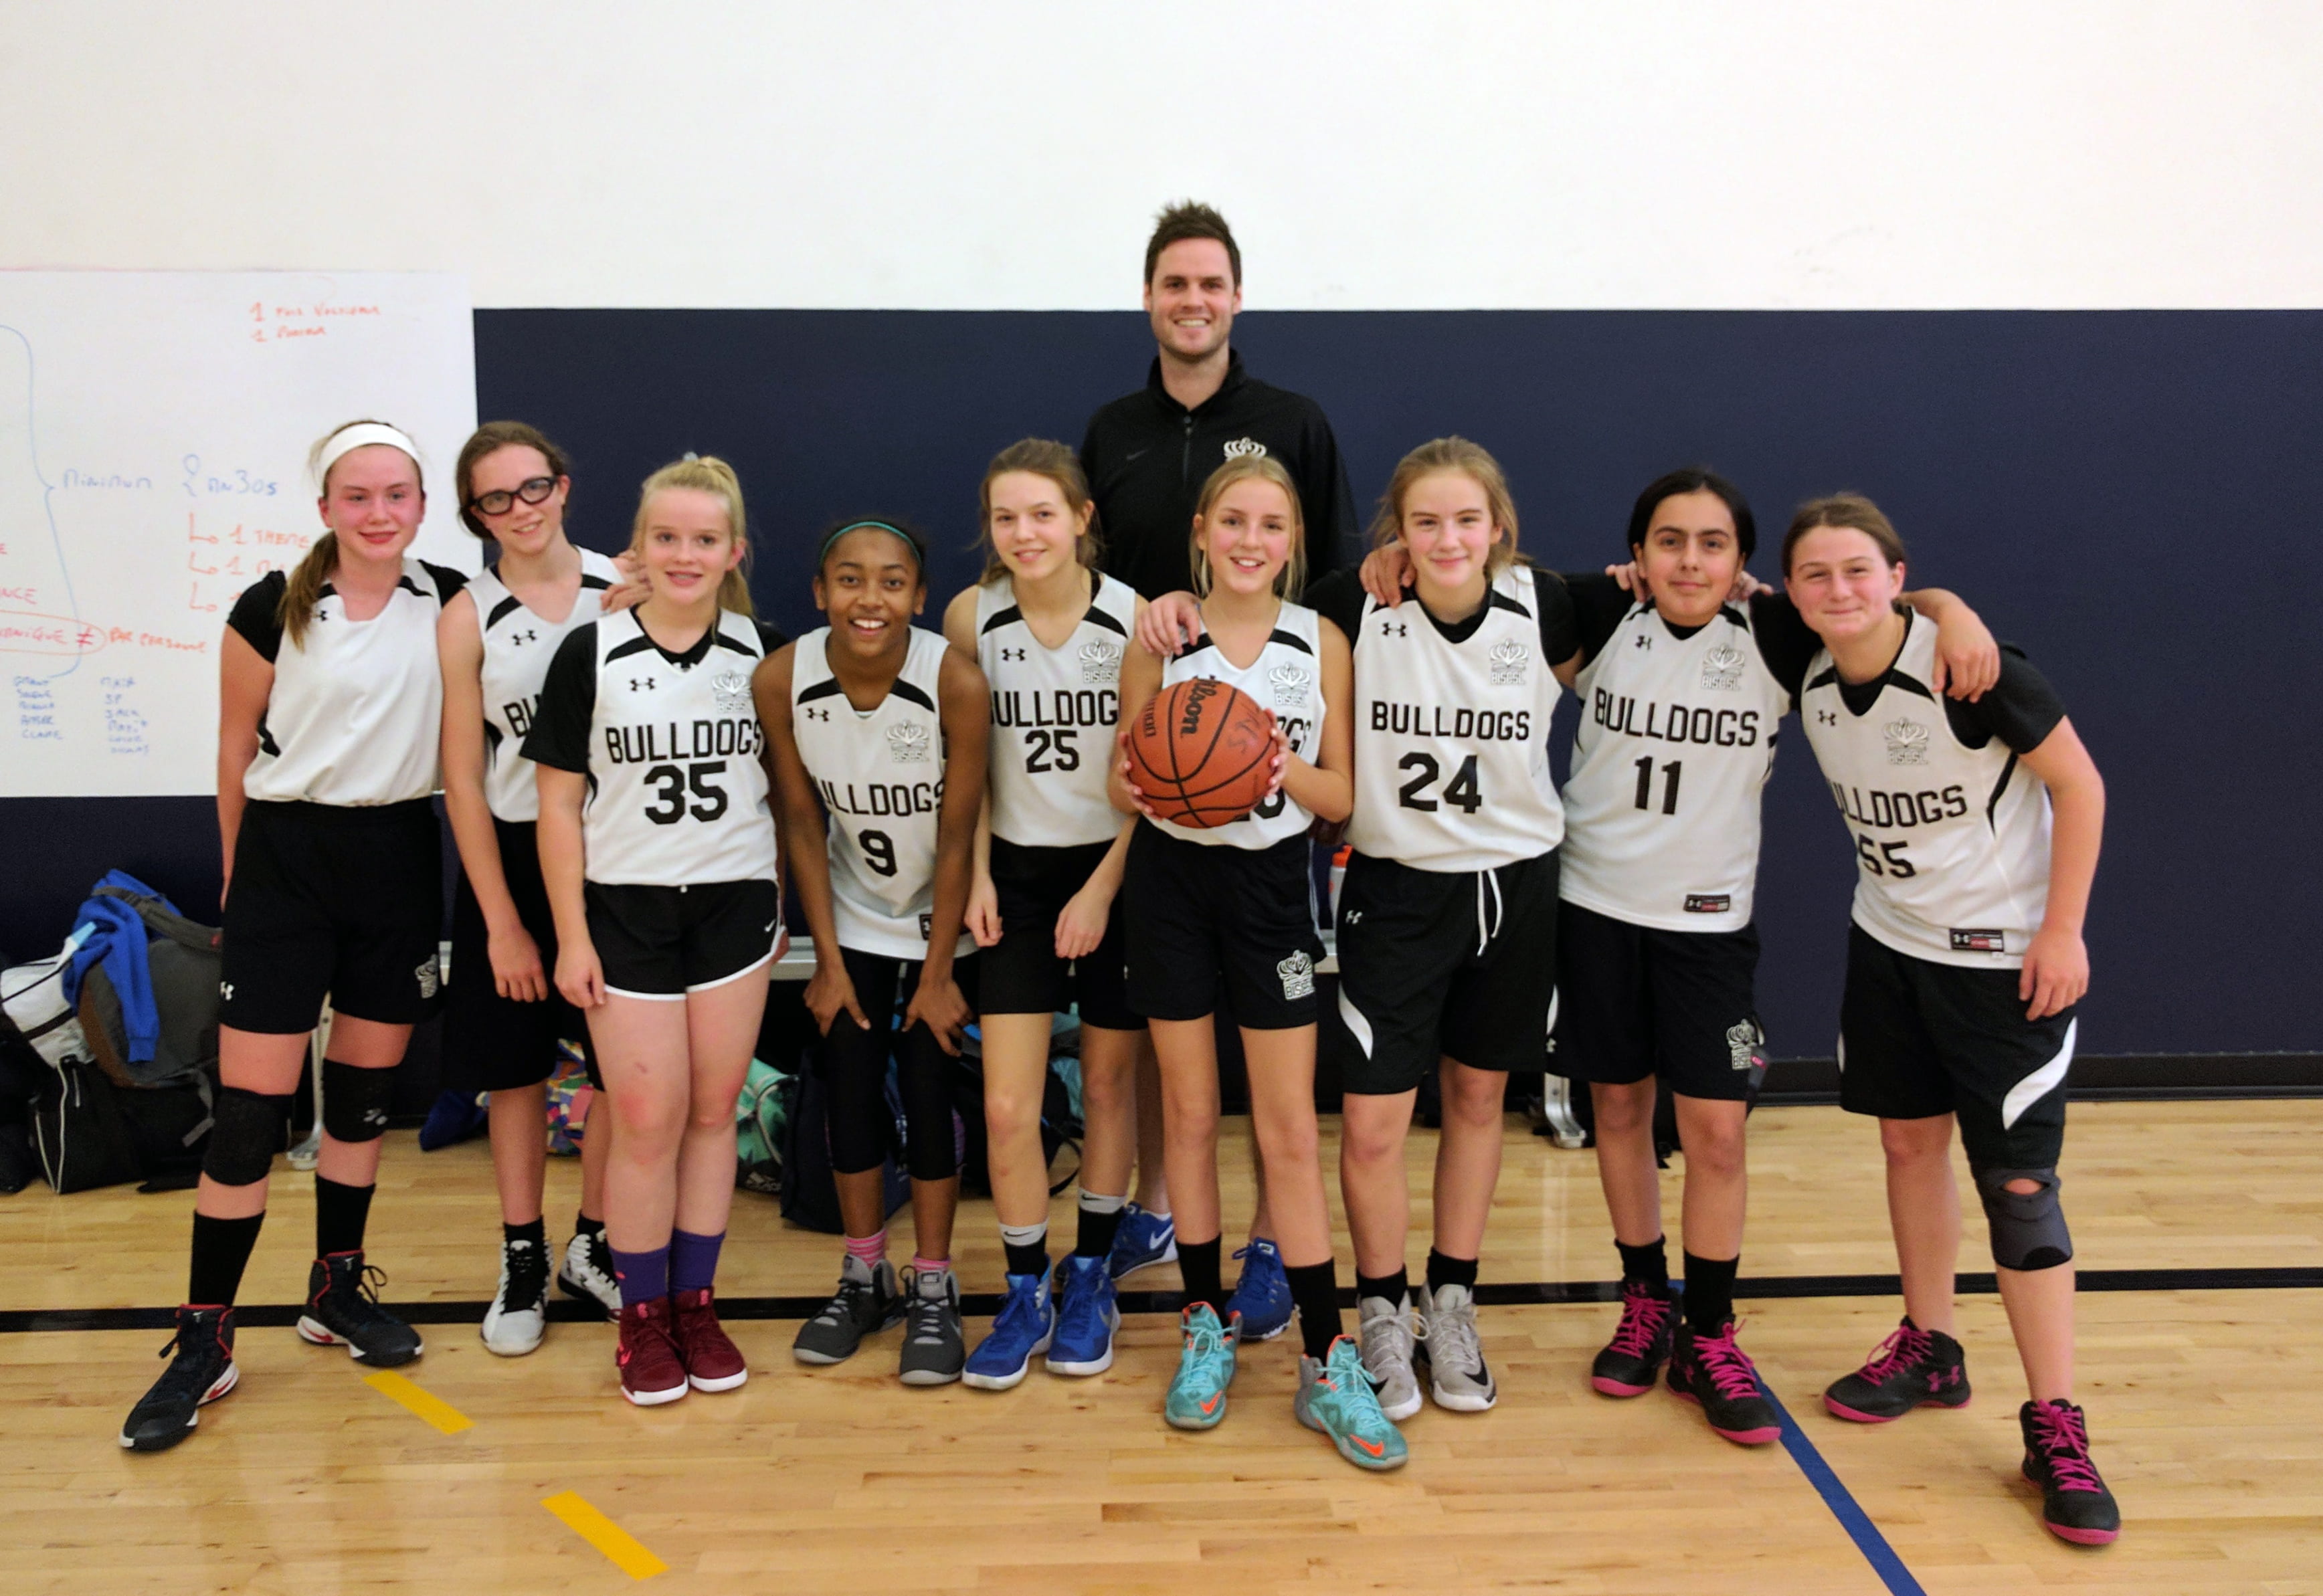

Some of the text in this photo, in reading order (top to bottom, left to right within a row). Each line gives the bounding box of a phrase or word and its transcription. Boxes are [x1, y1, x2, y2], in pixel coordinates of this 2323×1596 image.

[990, 690, 1120, 727] ULLDOG
[1372, 700, 1529, 740] BULLDOGS
[1594, 687, 1759, 746] BULLDOGS
[1024, 730, 1079, 773] 25
[644, 761, 728, 825] 35
[1398, 751, 1482, 813] 24
[1635, 756, 1681, 815] 11
[858, 829, 897, 877] 9
[1858, 832, 1916, 878] 55
